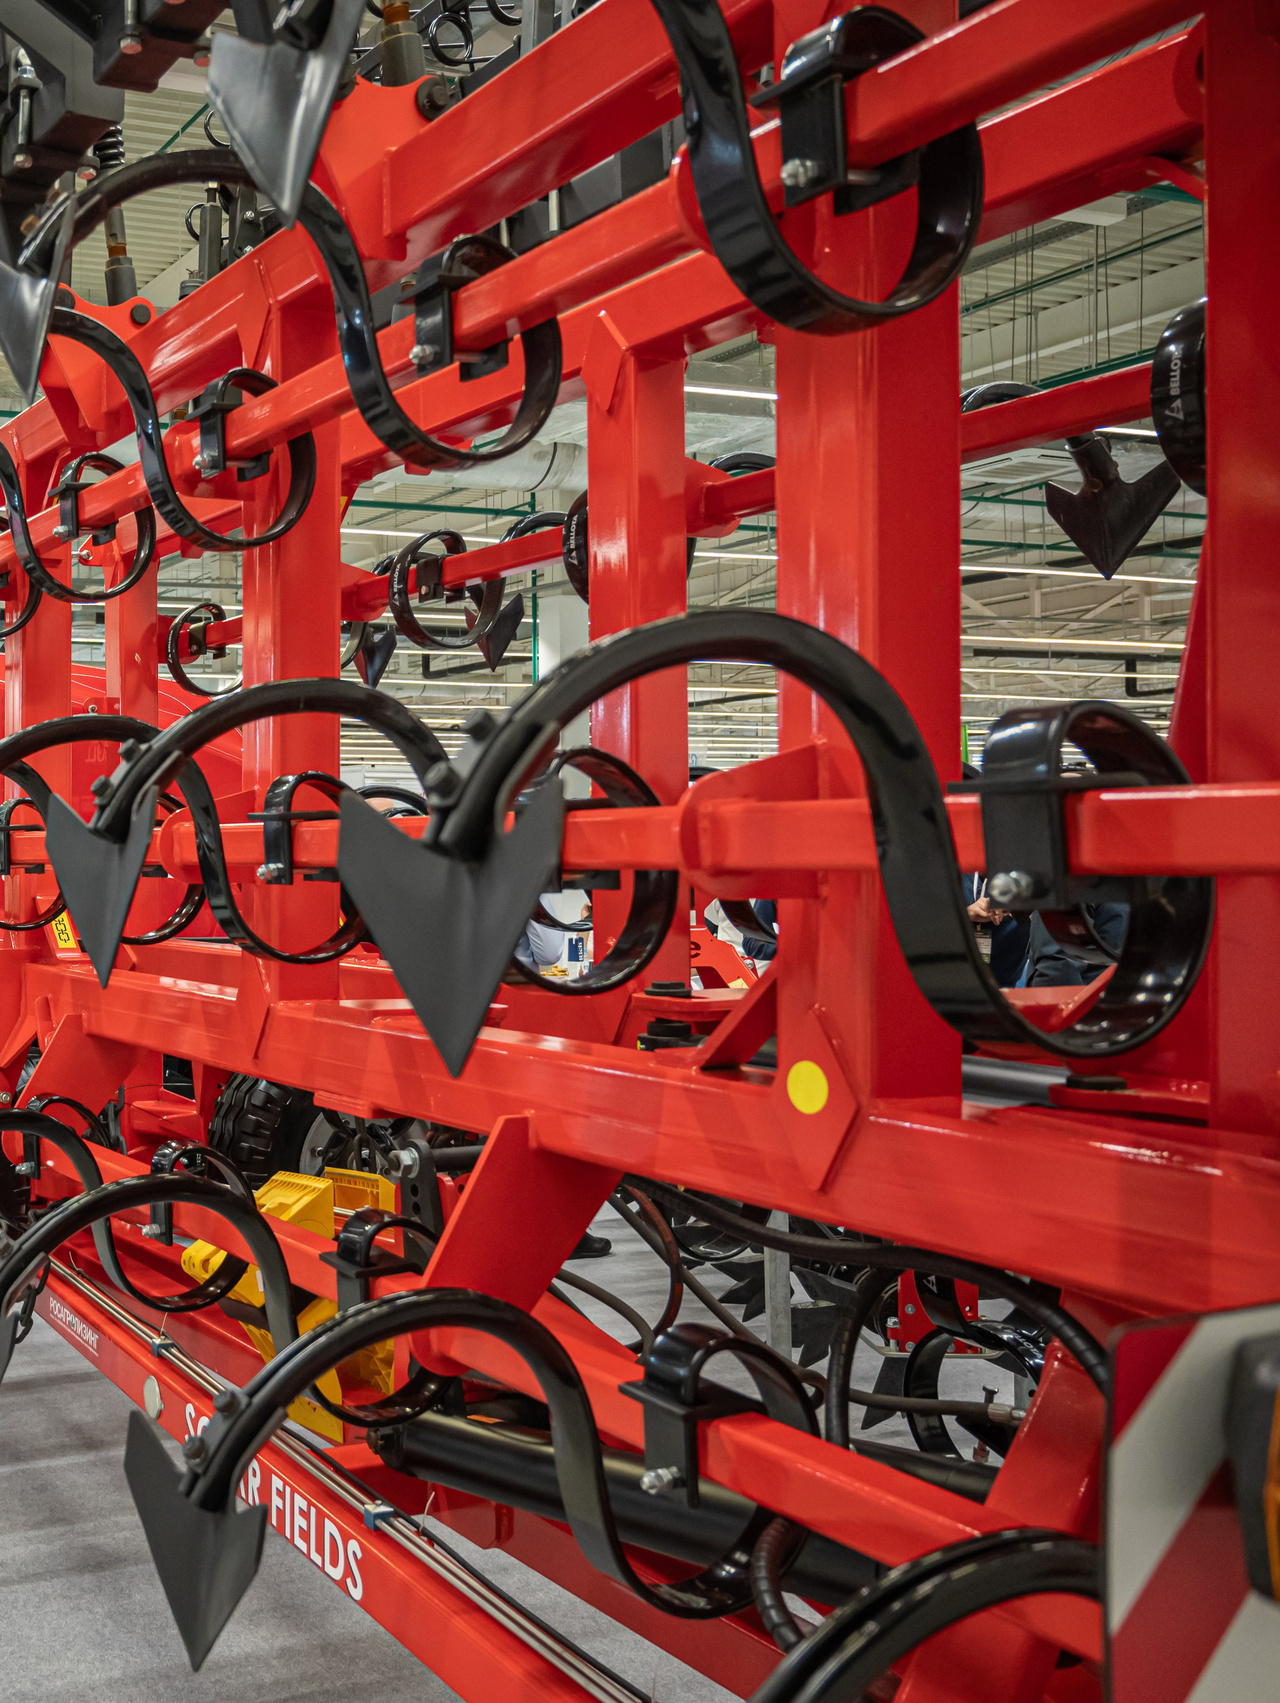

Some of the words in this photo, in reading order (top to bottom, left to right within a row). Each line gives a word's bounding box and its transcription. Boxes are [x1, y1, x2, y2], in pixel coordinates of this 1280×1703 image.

[570, 515, 578, 549] BELLOTA
[49, 1296, 99, 1350] РОСАГРОЛИЗИНГ
[270, 1472, 364, 1601] FIELDS
